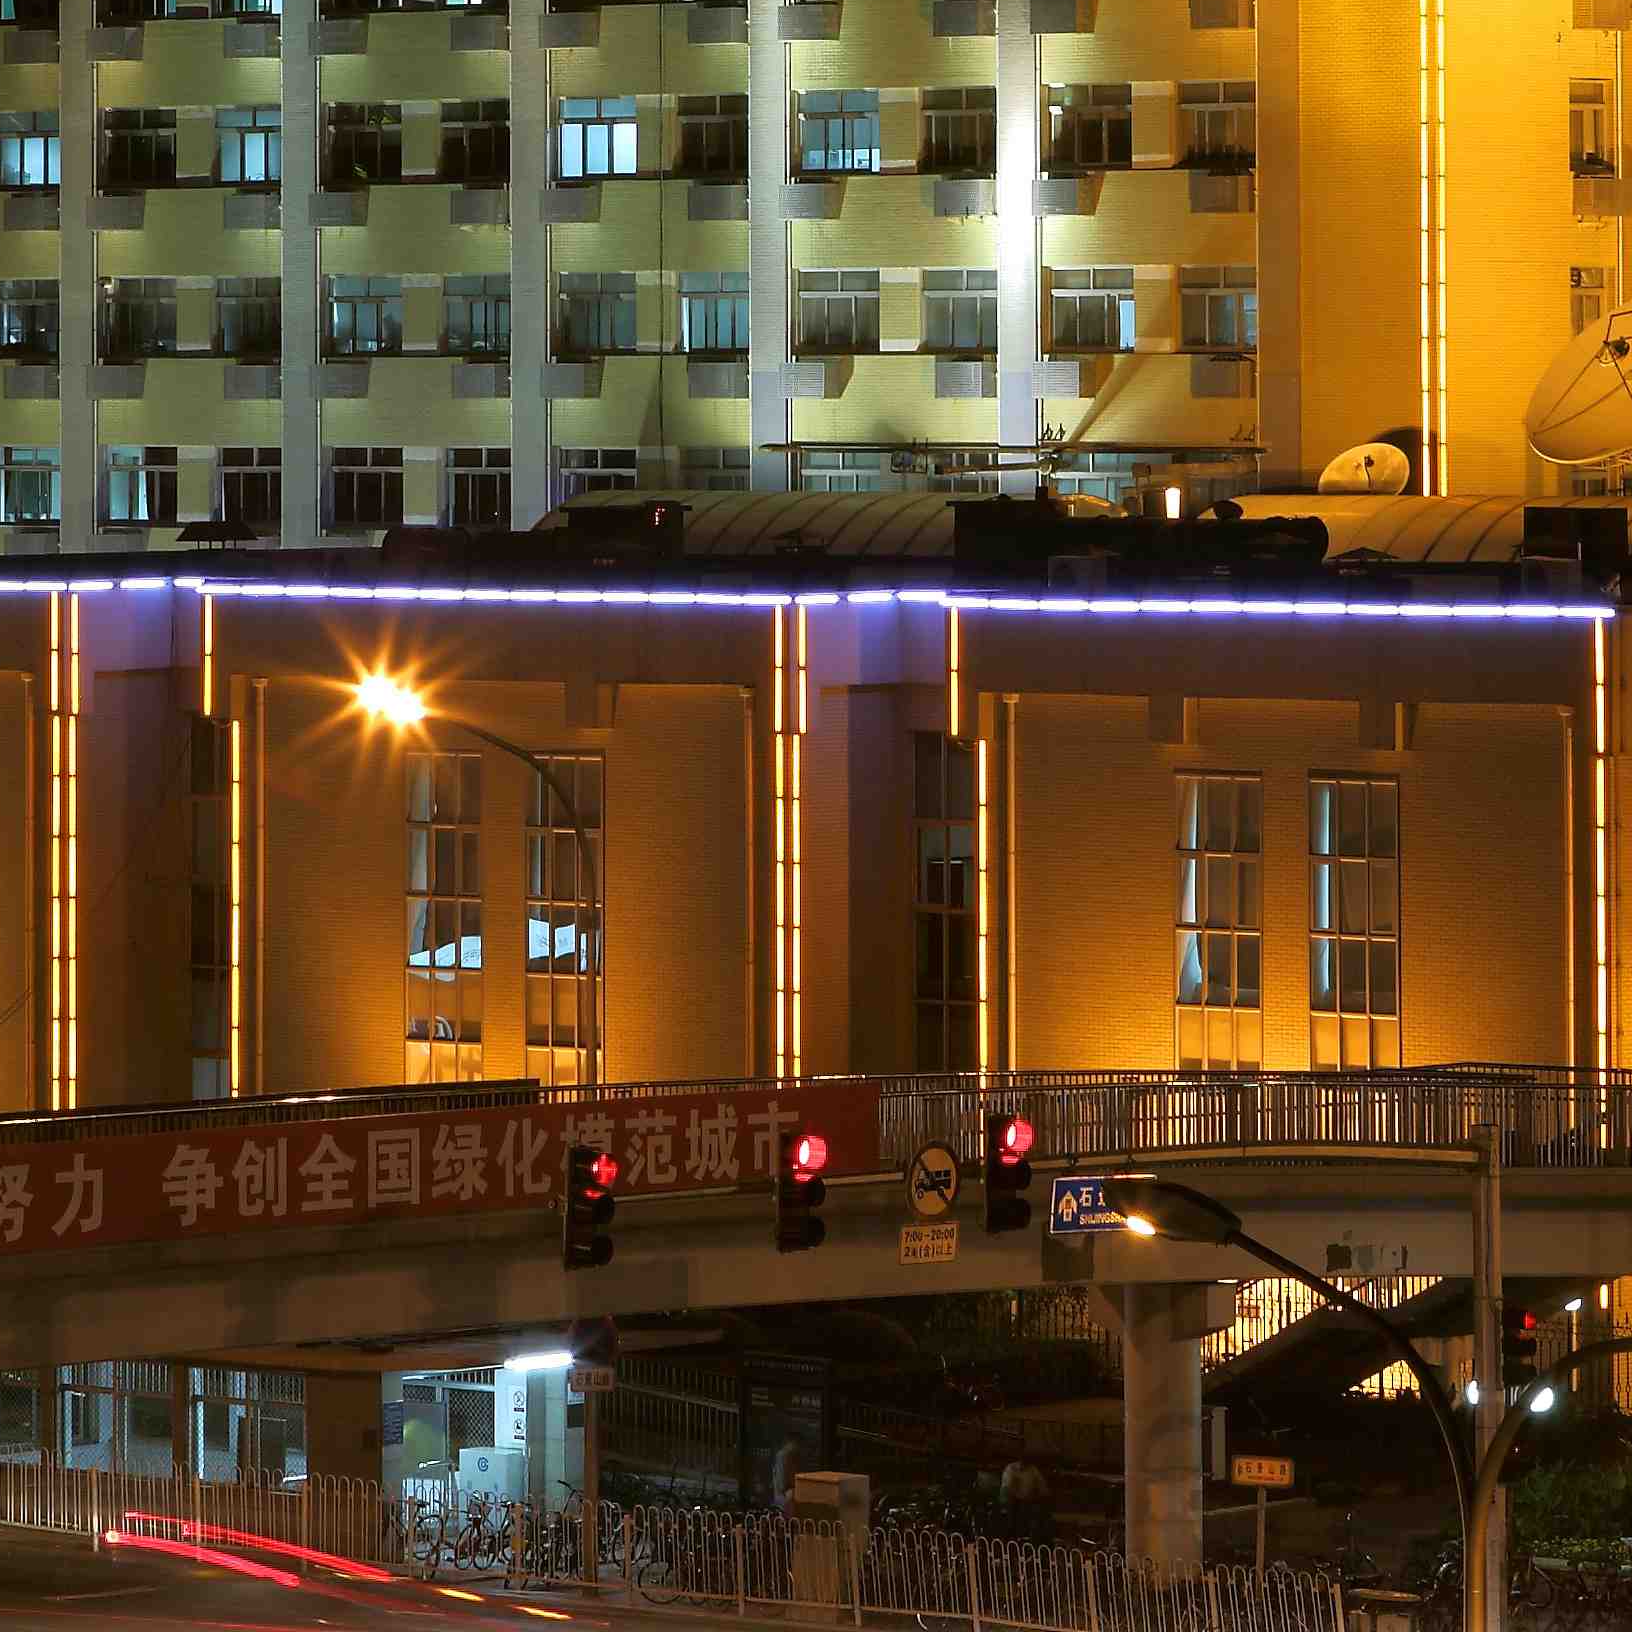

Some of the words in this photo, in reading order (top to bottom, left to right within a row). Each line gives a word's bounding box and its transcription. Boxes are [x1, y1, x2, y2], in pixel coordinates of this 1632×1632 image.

[163, 1101, 799, 1228] 争创全国绿化模范城市
